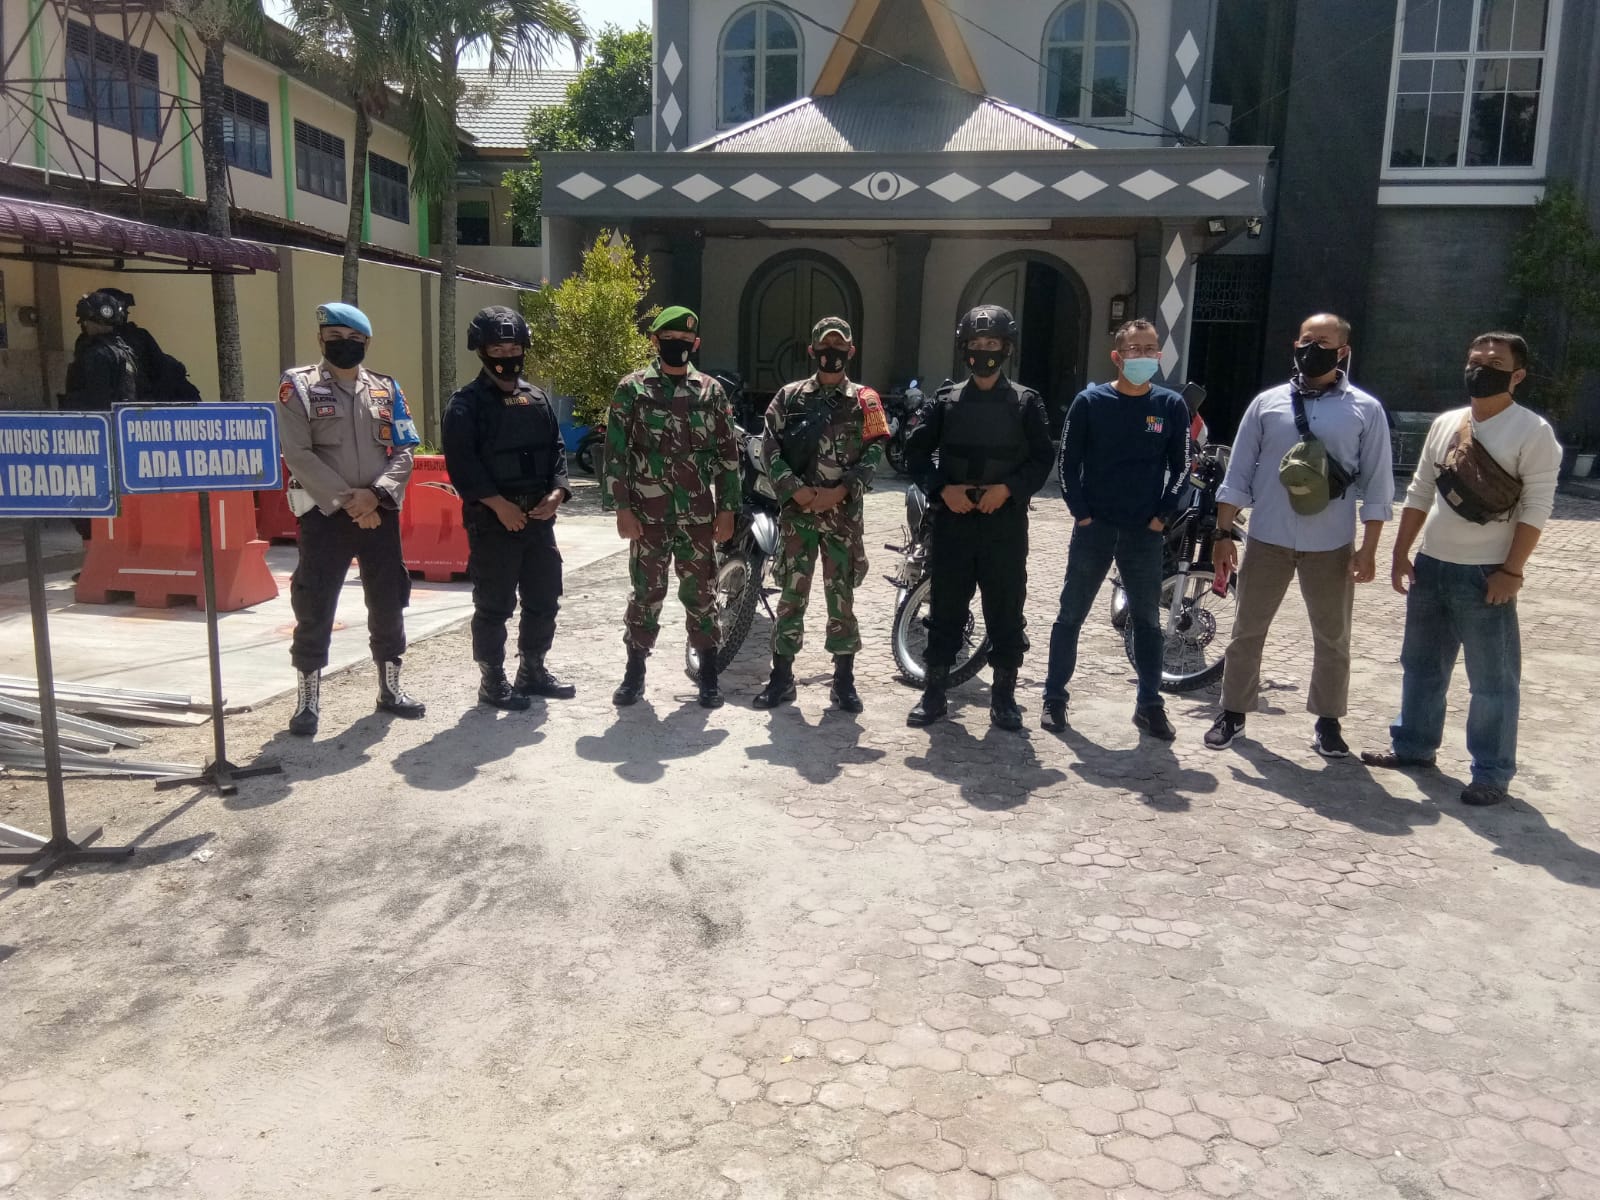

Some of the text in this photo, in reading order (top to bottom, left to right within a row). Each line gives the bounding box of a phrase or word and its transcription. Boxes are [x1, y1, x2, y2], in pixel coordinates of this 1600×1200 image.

[52, 429, 100, 455] JEMAAT
[127, 419, 267, 442] PARKIR KHUSUS JEMAAT
[138, 449, 263, 478] ADA IBADAH
[8, 464, 96, 496] IBADAH
